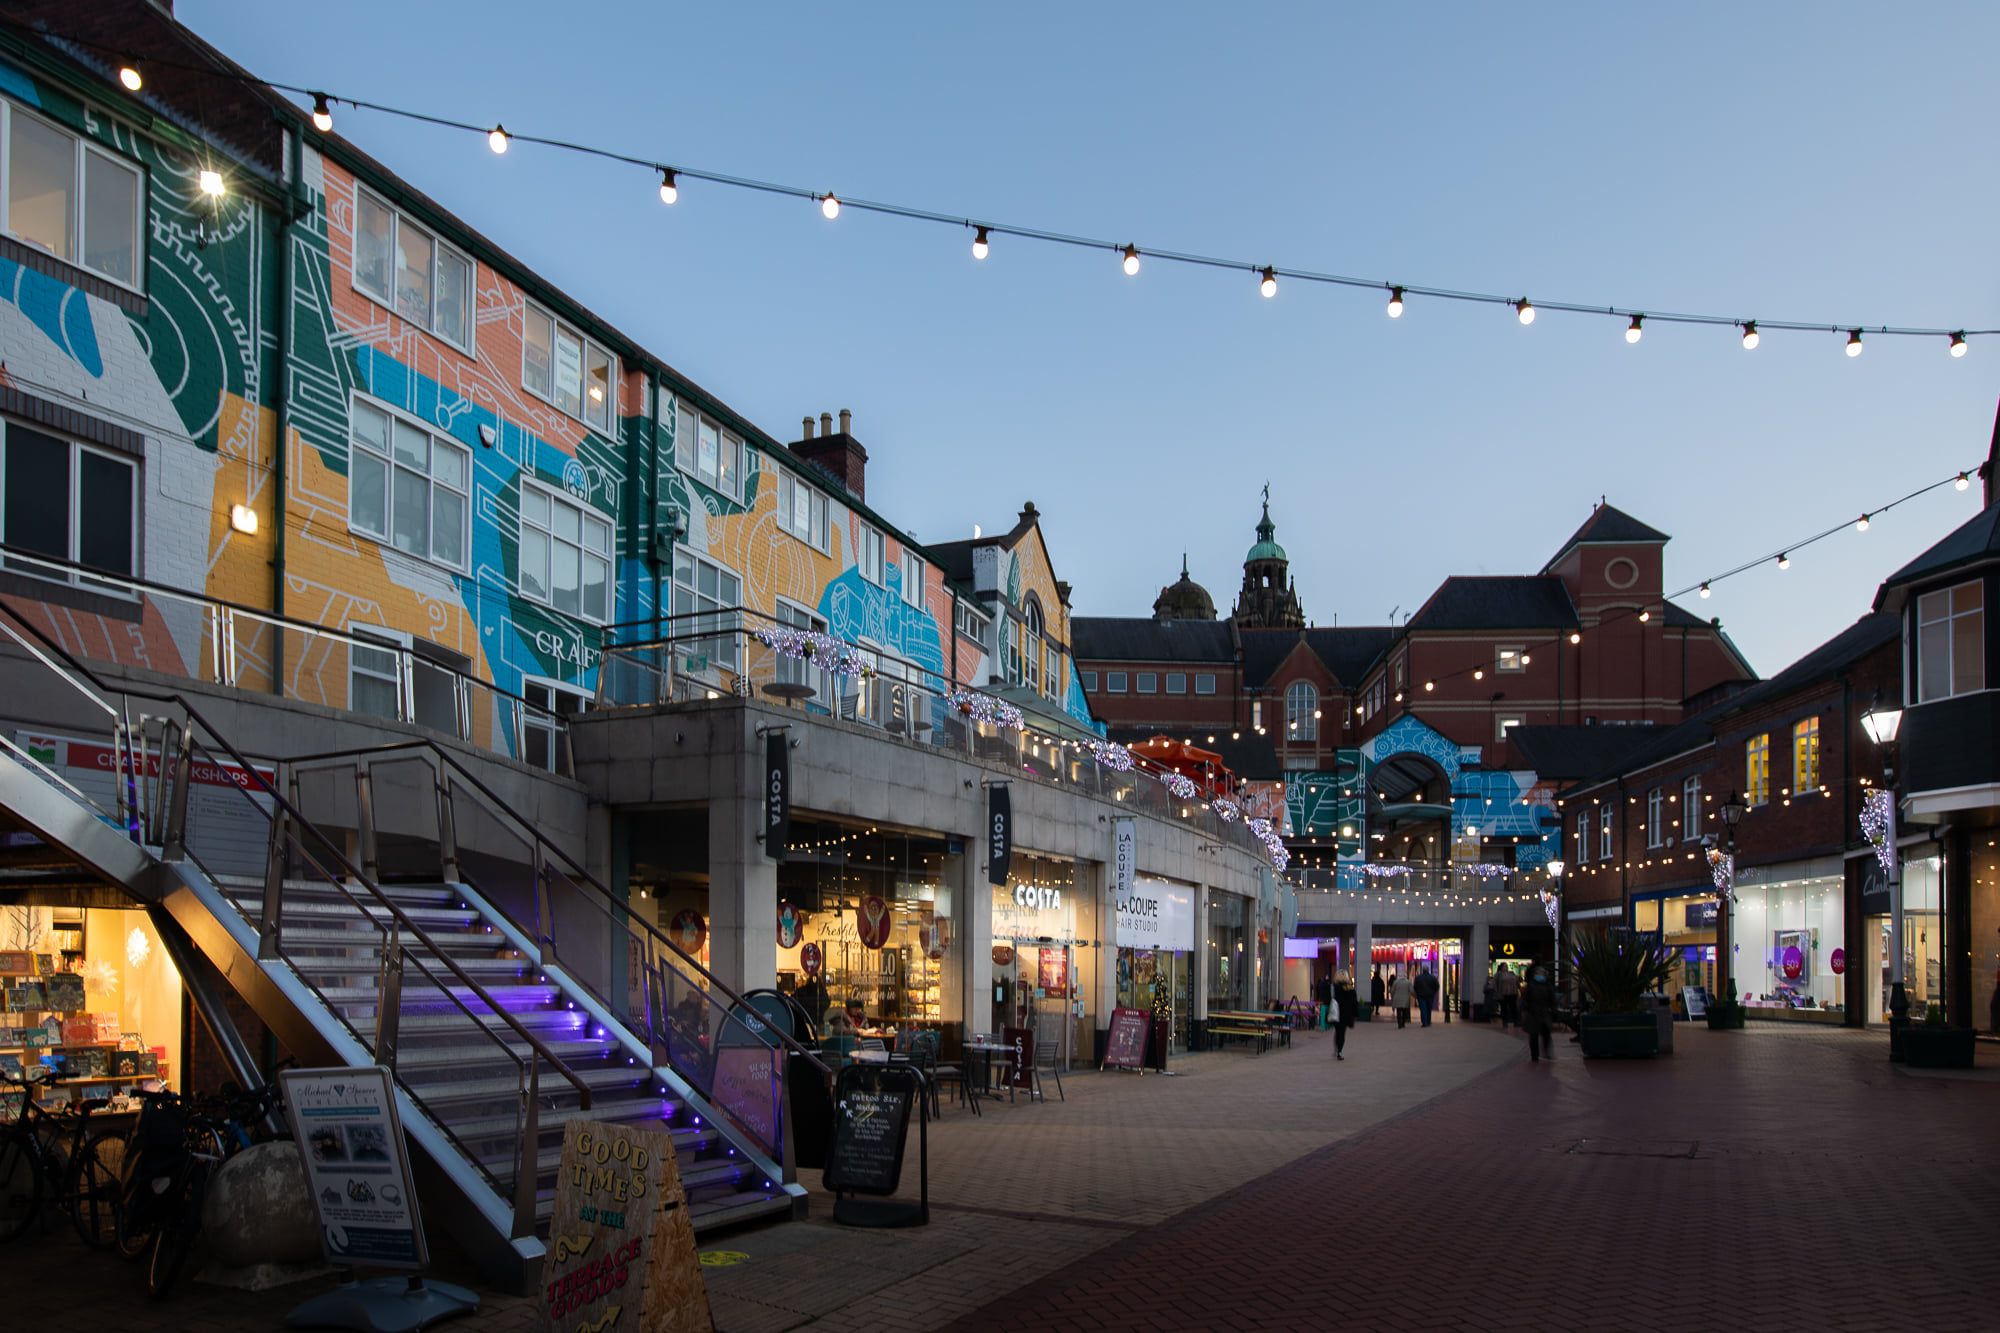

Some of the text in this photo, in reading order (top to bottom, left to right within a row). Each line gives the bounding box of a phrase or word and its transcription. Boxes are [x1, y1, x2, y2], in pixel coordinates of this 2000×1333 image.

[152, 761, 248, 786] WOKSHOPS
[770, 768, 782, 827] COSTA
[993, 813, 1004, 859] COSTA
[1118, 844, 1126, 891] COUPE
[1016, 884, 1061, 912] COSTA
[1863, 873, 1890, 897] Clark
[1129, 896, 1158, 918] COUPE
[1134, 919, 1158, 933] STUDIO
[851, 953, 896, 976] HELLO
[1015, 1036, 1024, 1081] COSTA
[297, 1085, 332, 1097] Michael
[851, 1093, 880, 1103] Tattoo
[576, 1131, 649, 1171] GOOD
[572, 1162, 647, 1203] TIMES
[579, 1206, 626, 1229] AT THE
[546, 1235, 643, 1304] TERRACE
[551, 1265, 629, 1320] GOODS
